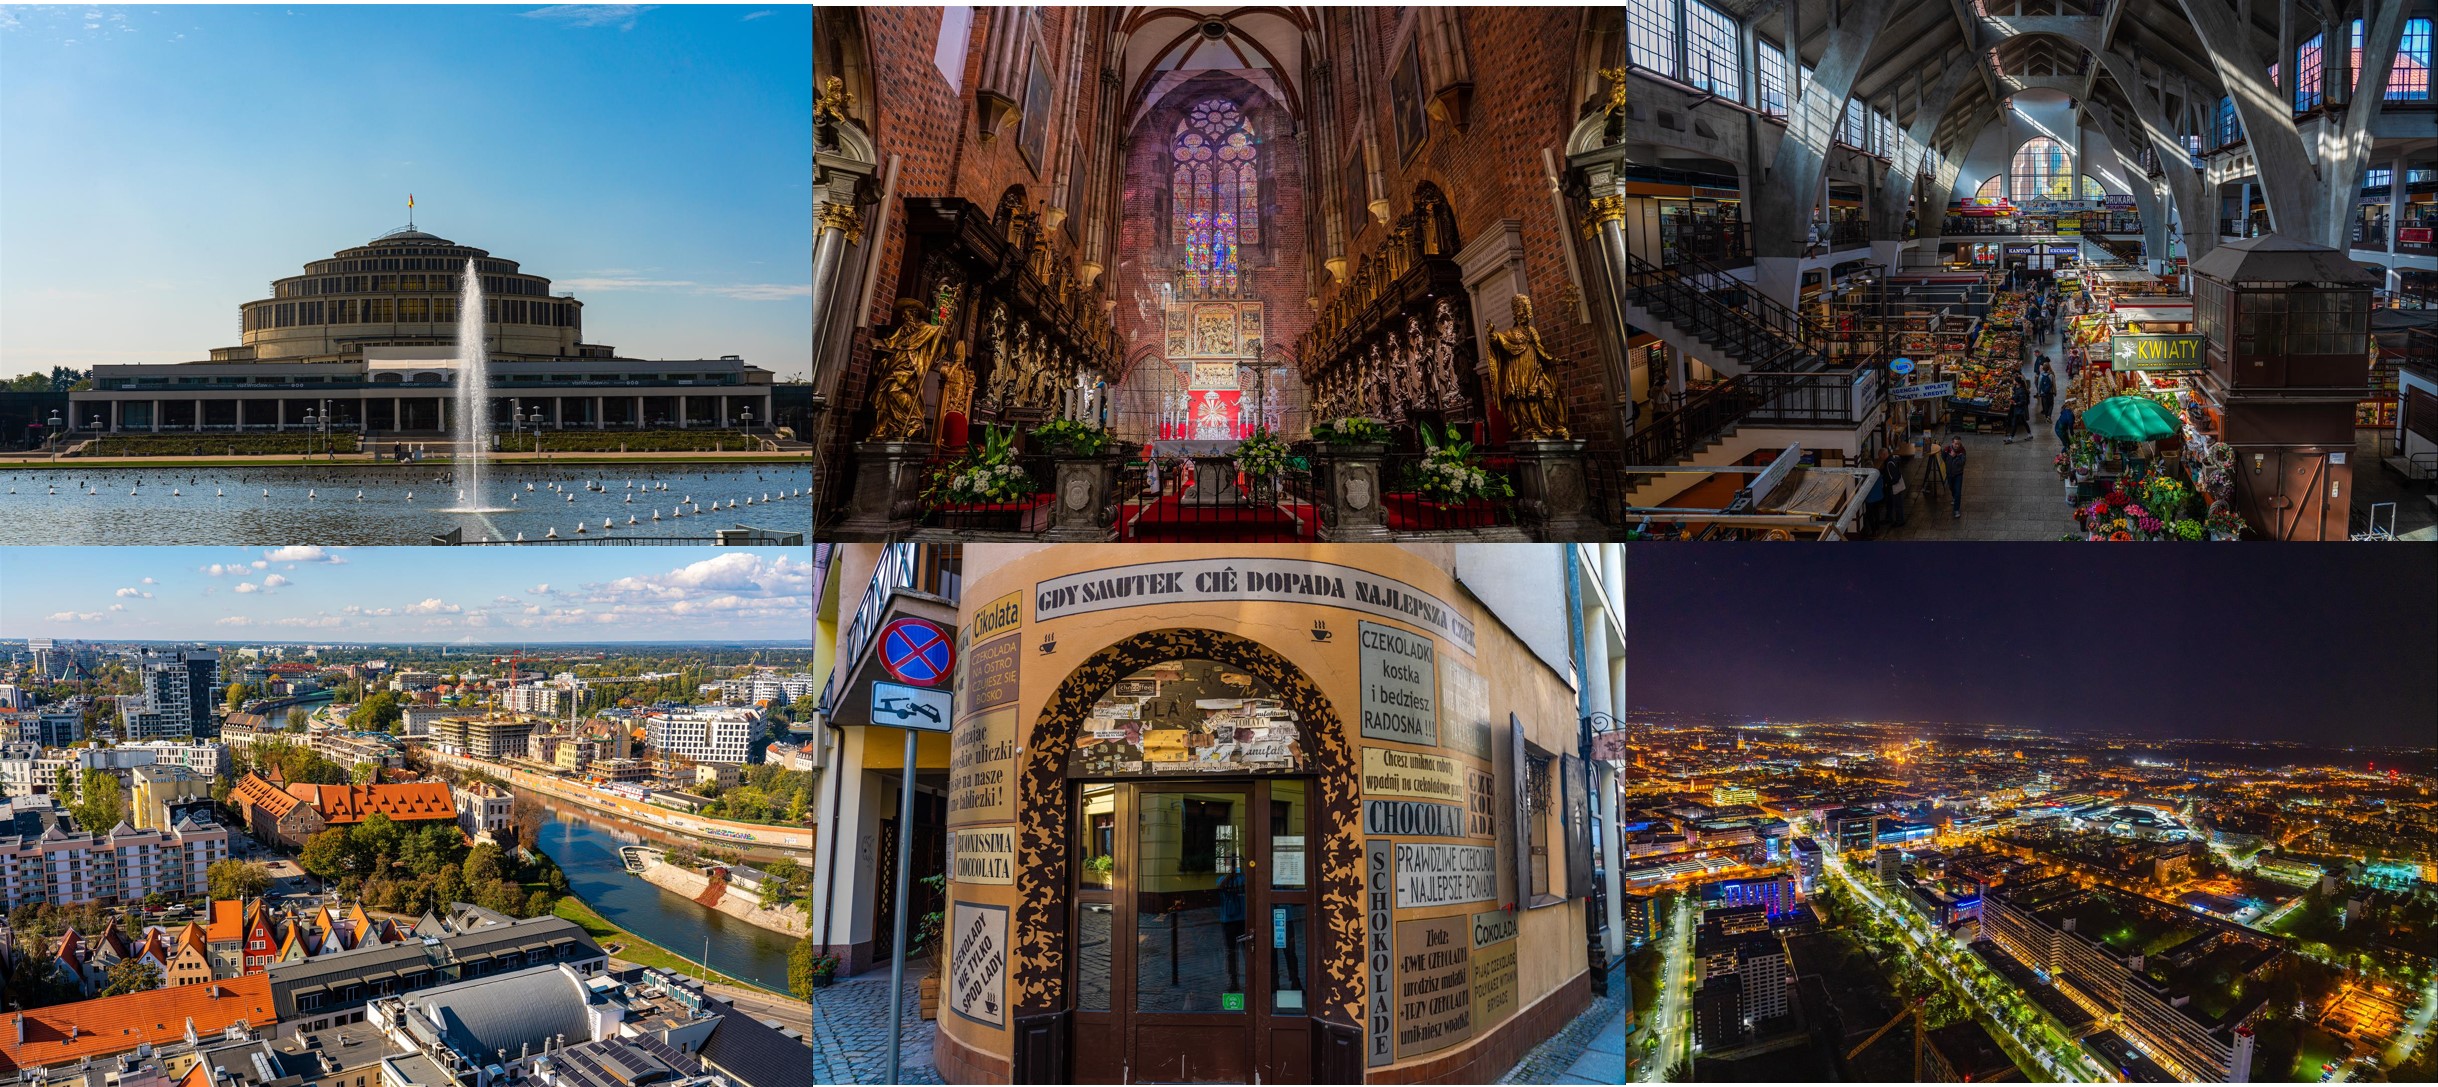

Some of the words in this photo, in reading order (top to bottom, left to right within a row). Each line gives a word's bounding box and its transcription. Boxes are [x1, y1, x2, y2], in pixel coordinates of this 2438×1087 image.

[2138, 340, 2199, 360] KWIATY
[1038, 584, 1079, 612] GDY
[1082, 572, 1184, 603] SMUTEK
[1247, 571, 1346, 598] DOPADA
[1356, 581, 1448, 630] NAJLEPSZA
[974, 601, 1018, 638] Cikolata
[972, 641, 1016, 666] CZEKOLADA
[1362, 630, 1433, 664] CZEKOLADKI
[972, 667, 982, 678] NA
[984, 657, 1012, 674] OSTRO
[1384, 659, 1420, 684] kostka
[972, 674, 1002, 692] CZUJESZ
[1004, 670, 1016, 684] SIĘ
[976, 688, 1002, 704] BOSKO
[1372, 684, 1376, 702] i
[1380, 685, 1430, 712] bedziesz
[1364, 710, 1422, 736] RADOSNA
[1425, 720, 1436, 738] !!!
[976, 740, 1012, 764] uliczki
[1384, 750, 1408, 768] Chcesz
[1410, 754, 1436, 773] uniknac
[1436, 758, 1454, 776] roboty
[962, 774, 972, 788] na
[974, 770, 1003, 786] nasze
[1366, 773, 1400, 792] wpadnij
[1402, 778, 1412, 791] na
[1414, 778, 1450, 796] czekoladowe
[1468, 772, 1493, 796] CZE
[960, 787, 995, 810] tabliczki
[1470, 792, 1494, 816] KOL
[1370, 800, 1462, 836] CHOCOLAT
[1470, 814, 1494, 836] ADA
[958, 833, 1012, 853] BUONISSIMA
[958, 858, 1010, 878] CIOCCOLATA
[1398, 846, 1456, 873] PRAWDZIWE
[1410, 875, 1462, 903] NAJLEPSZE
[1474, 915, 1518, 946] ČOKOLADA
[952, 912, 986, 976] CZEKOLADY
[1371, 851, 1389, 1056] SCHOKOLADE
[958, 968, 970, 992] NIE
[968, 935, 992, 974] TYLKO
[1428, 946, 1468, 970] CZEKOLADKI
[962, 980, 982, 1014] SPOD
[980, 950, 1003, 986] LADY
[1404, 976, 1440, 998] urodzisz
[1429, 990, 1469, 1016] CZEKOLADKI
[1400, 1022, 1442, 1045] unikniesz
